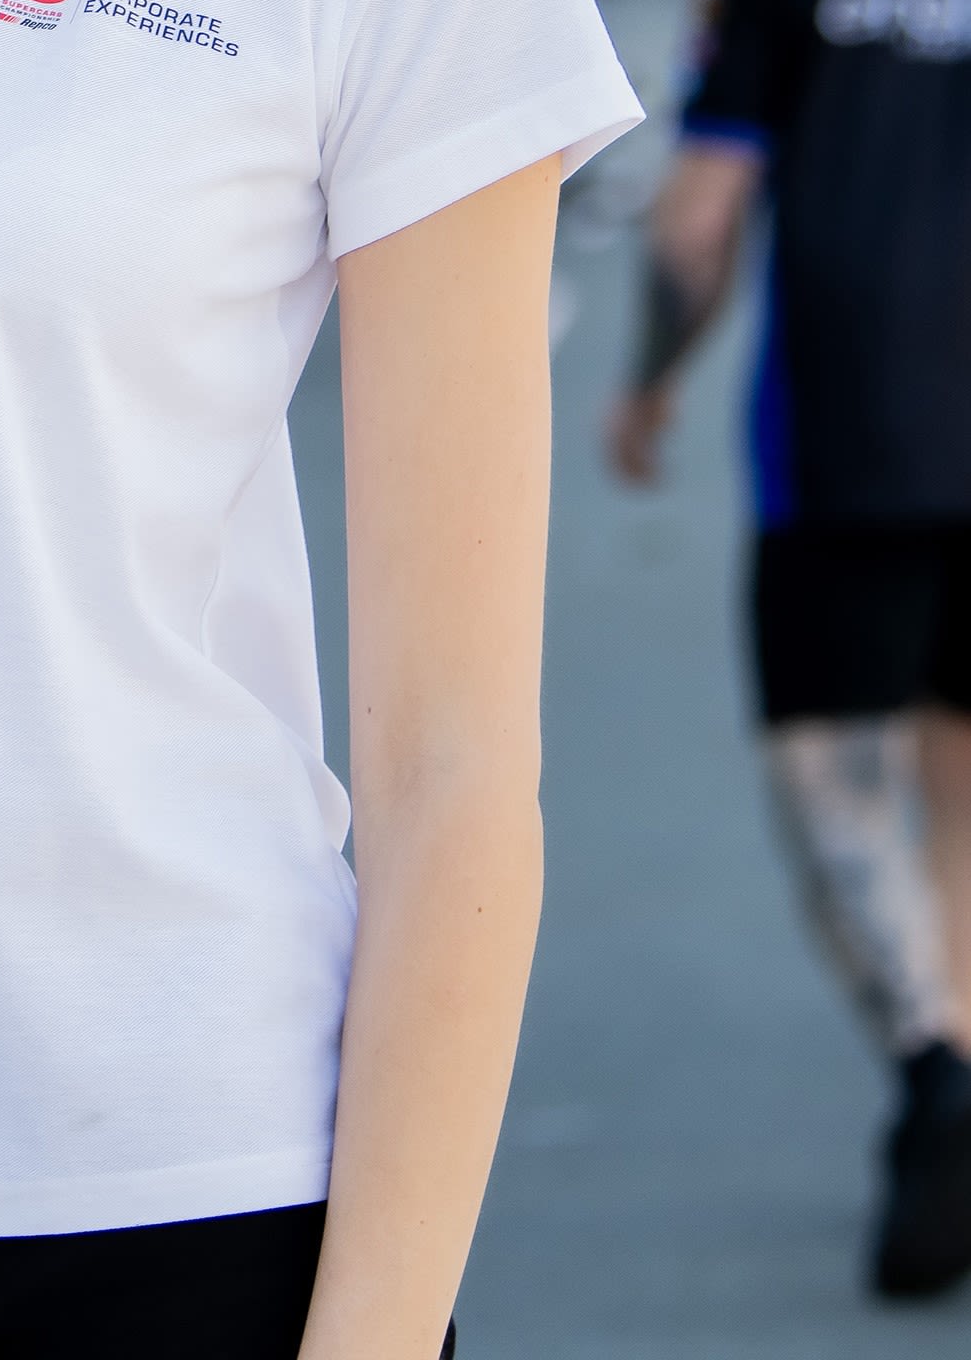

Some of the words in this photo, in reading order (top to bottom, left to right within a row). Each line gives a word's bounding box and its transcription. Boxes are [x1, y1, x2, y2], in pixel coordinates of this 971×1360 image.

[0, 5, 61, 22] CHAMPIONSHIP
[20, 18, 57, 30] Repco
[84, 0, 240, 57] EXPERIENCES
